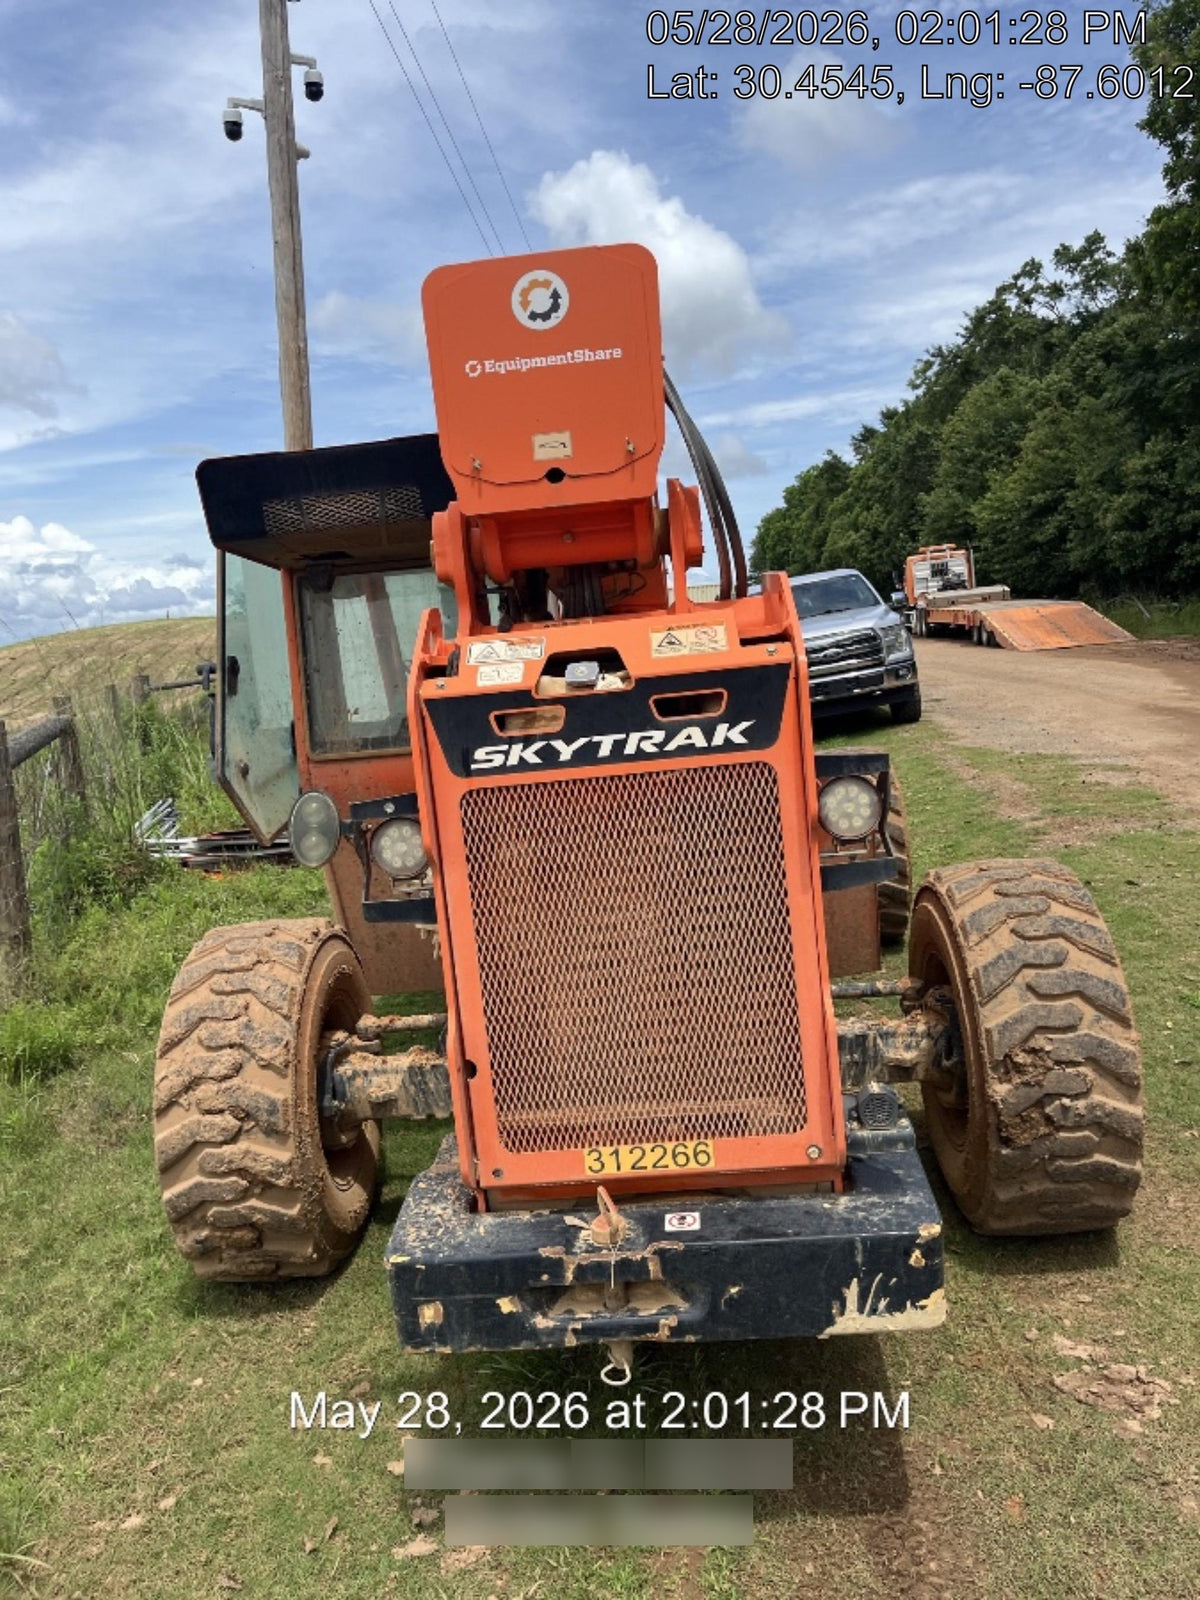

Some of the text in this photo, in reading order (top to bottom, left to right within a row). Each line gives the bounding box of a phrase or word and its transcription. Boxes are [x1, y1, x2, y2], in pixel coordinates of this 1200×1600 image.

[484, 347, 622, 374] EquipmentShare
[470, 719, 756, 771] SKYTRAK
[586, 1141, 712, 1174] 312266
